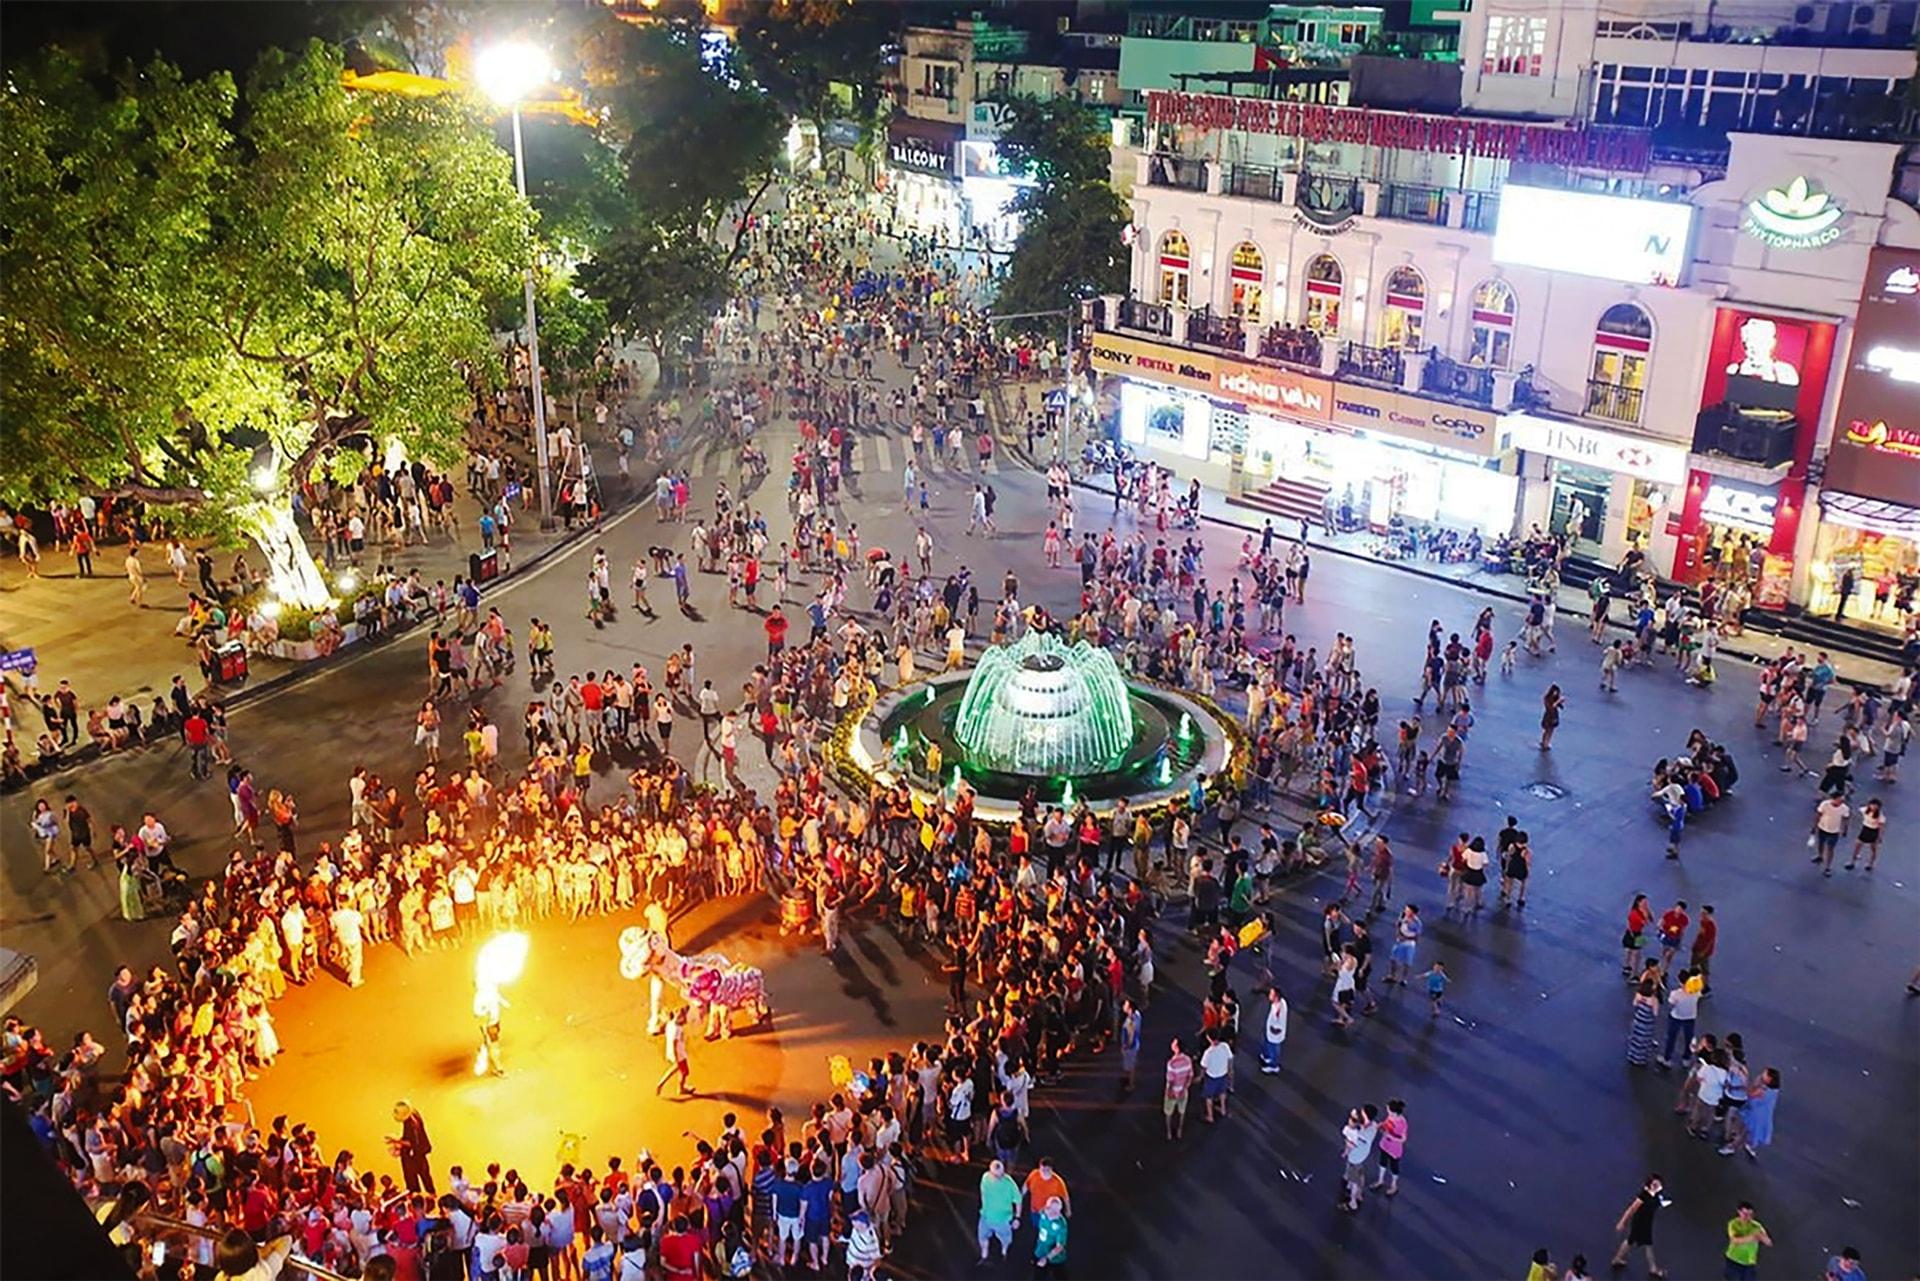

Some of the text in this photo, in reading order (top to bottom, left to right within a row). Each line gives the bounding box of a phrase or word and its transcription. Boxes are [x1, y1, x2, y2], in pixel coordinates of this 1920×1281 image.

[891, 145, 946, 170] BALCONY
[1093, 347, 1212, 382] SONY PENTAX Nikon
[1336, 400, 1485, 435] TAMRON Canon GoPro
[1546, 428, 1600, 456] HSBC
[1701, 485, 1777, 525] KFC
